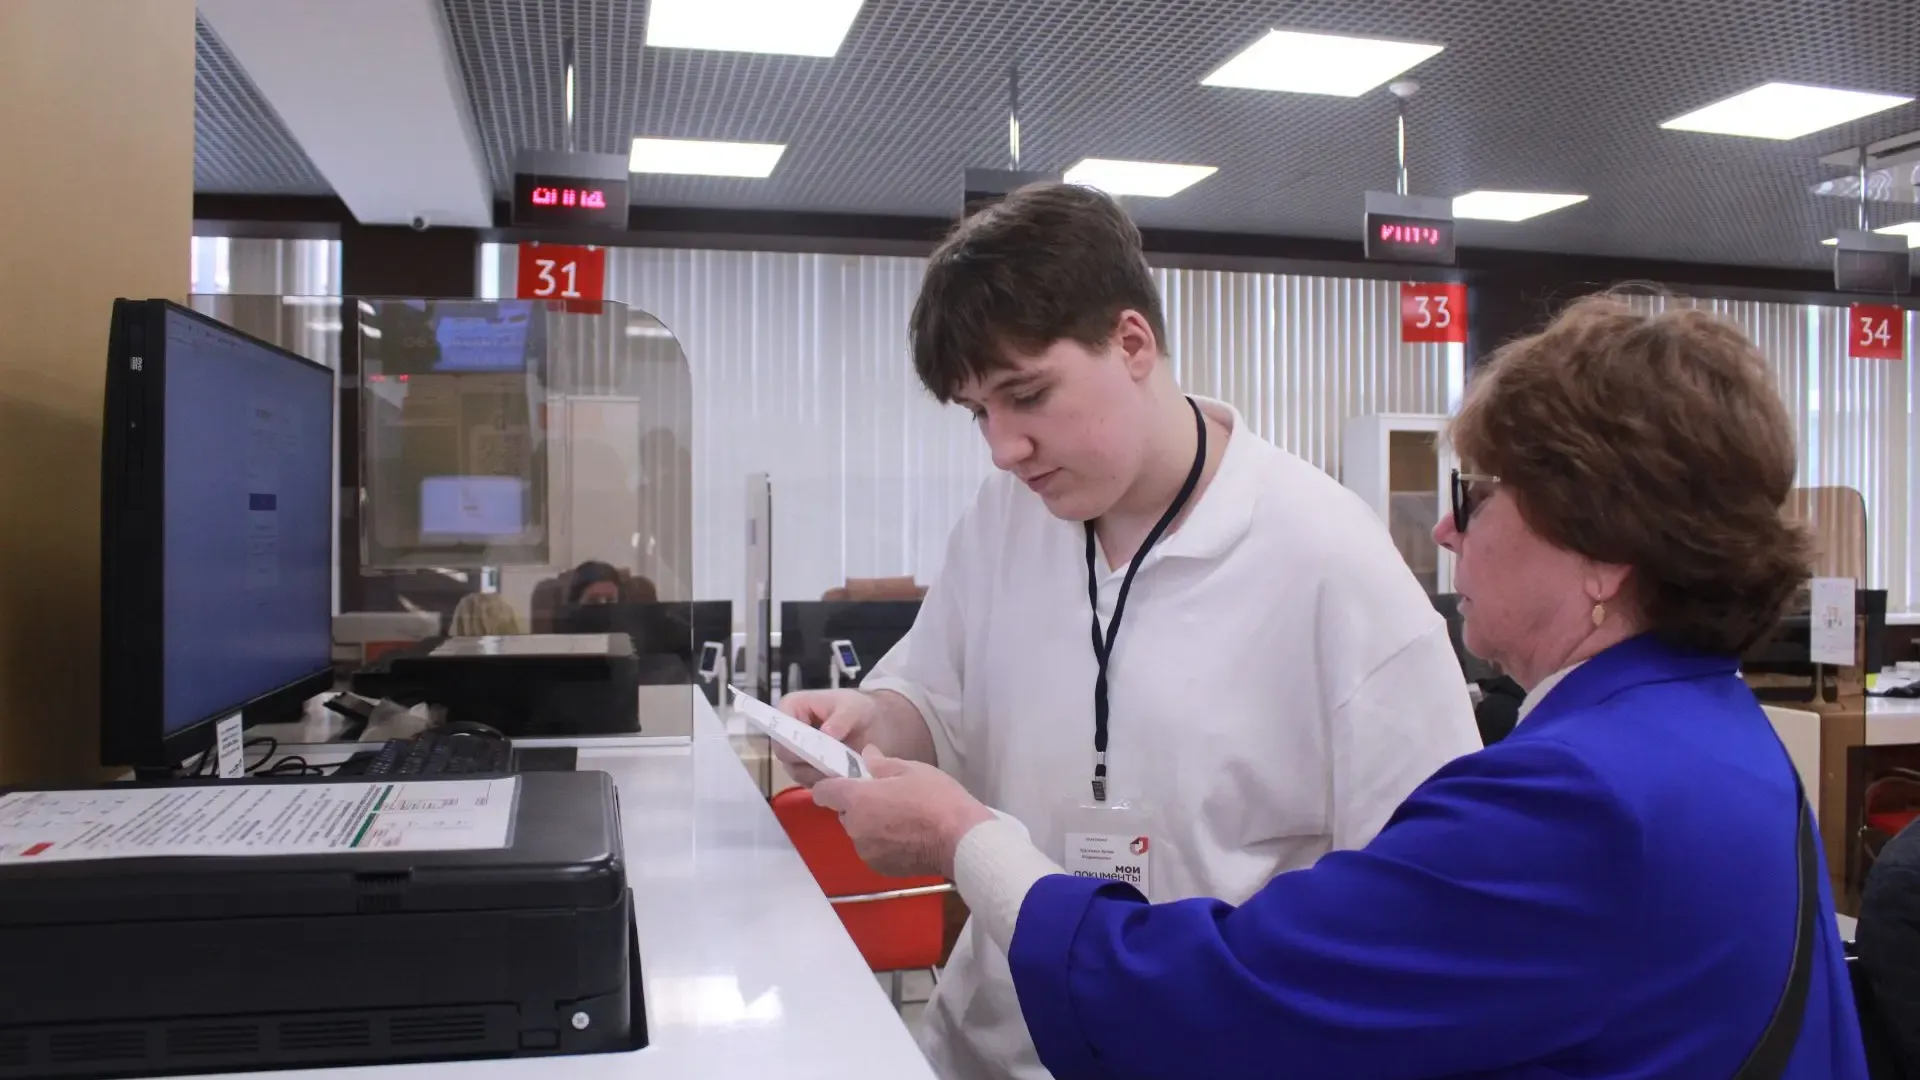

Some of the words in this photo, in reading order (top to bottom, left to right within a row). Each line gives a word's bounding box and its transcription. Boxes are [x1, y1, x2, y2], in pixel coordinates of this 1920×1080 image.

[534, 259, 581, 298] 31
[1415, 296, 1451, 329] 33
[1860, 317, 1892, 348] 34
